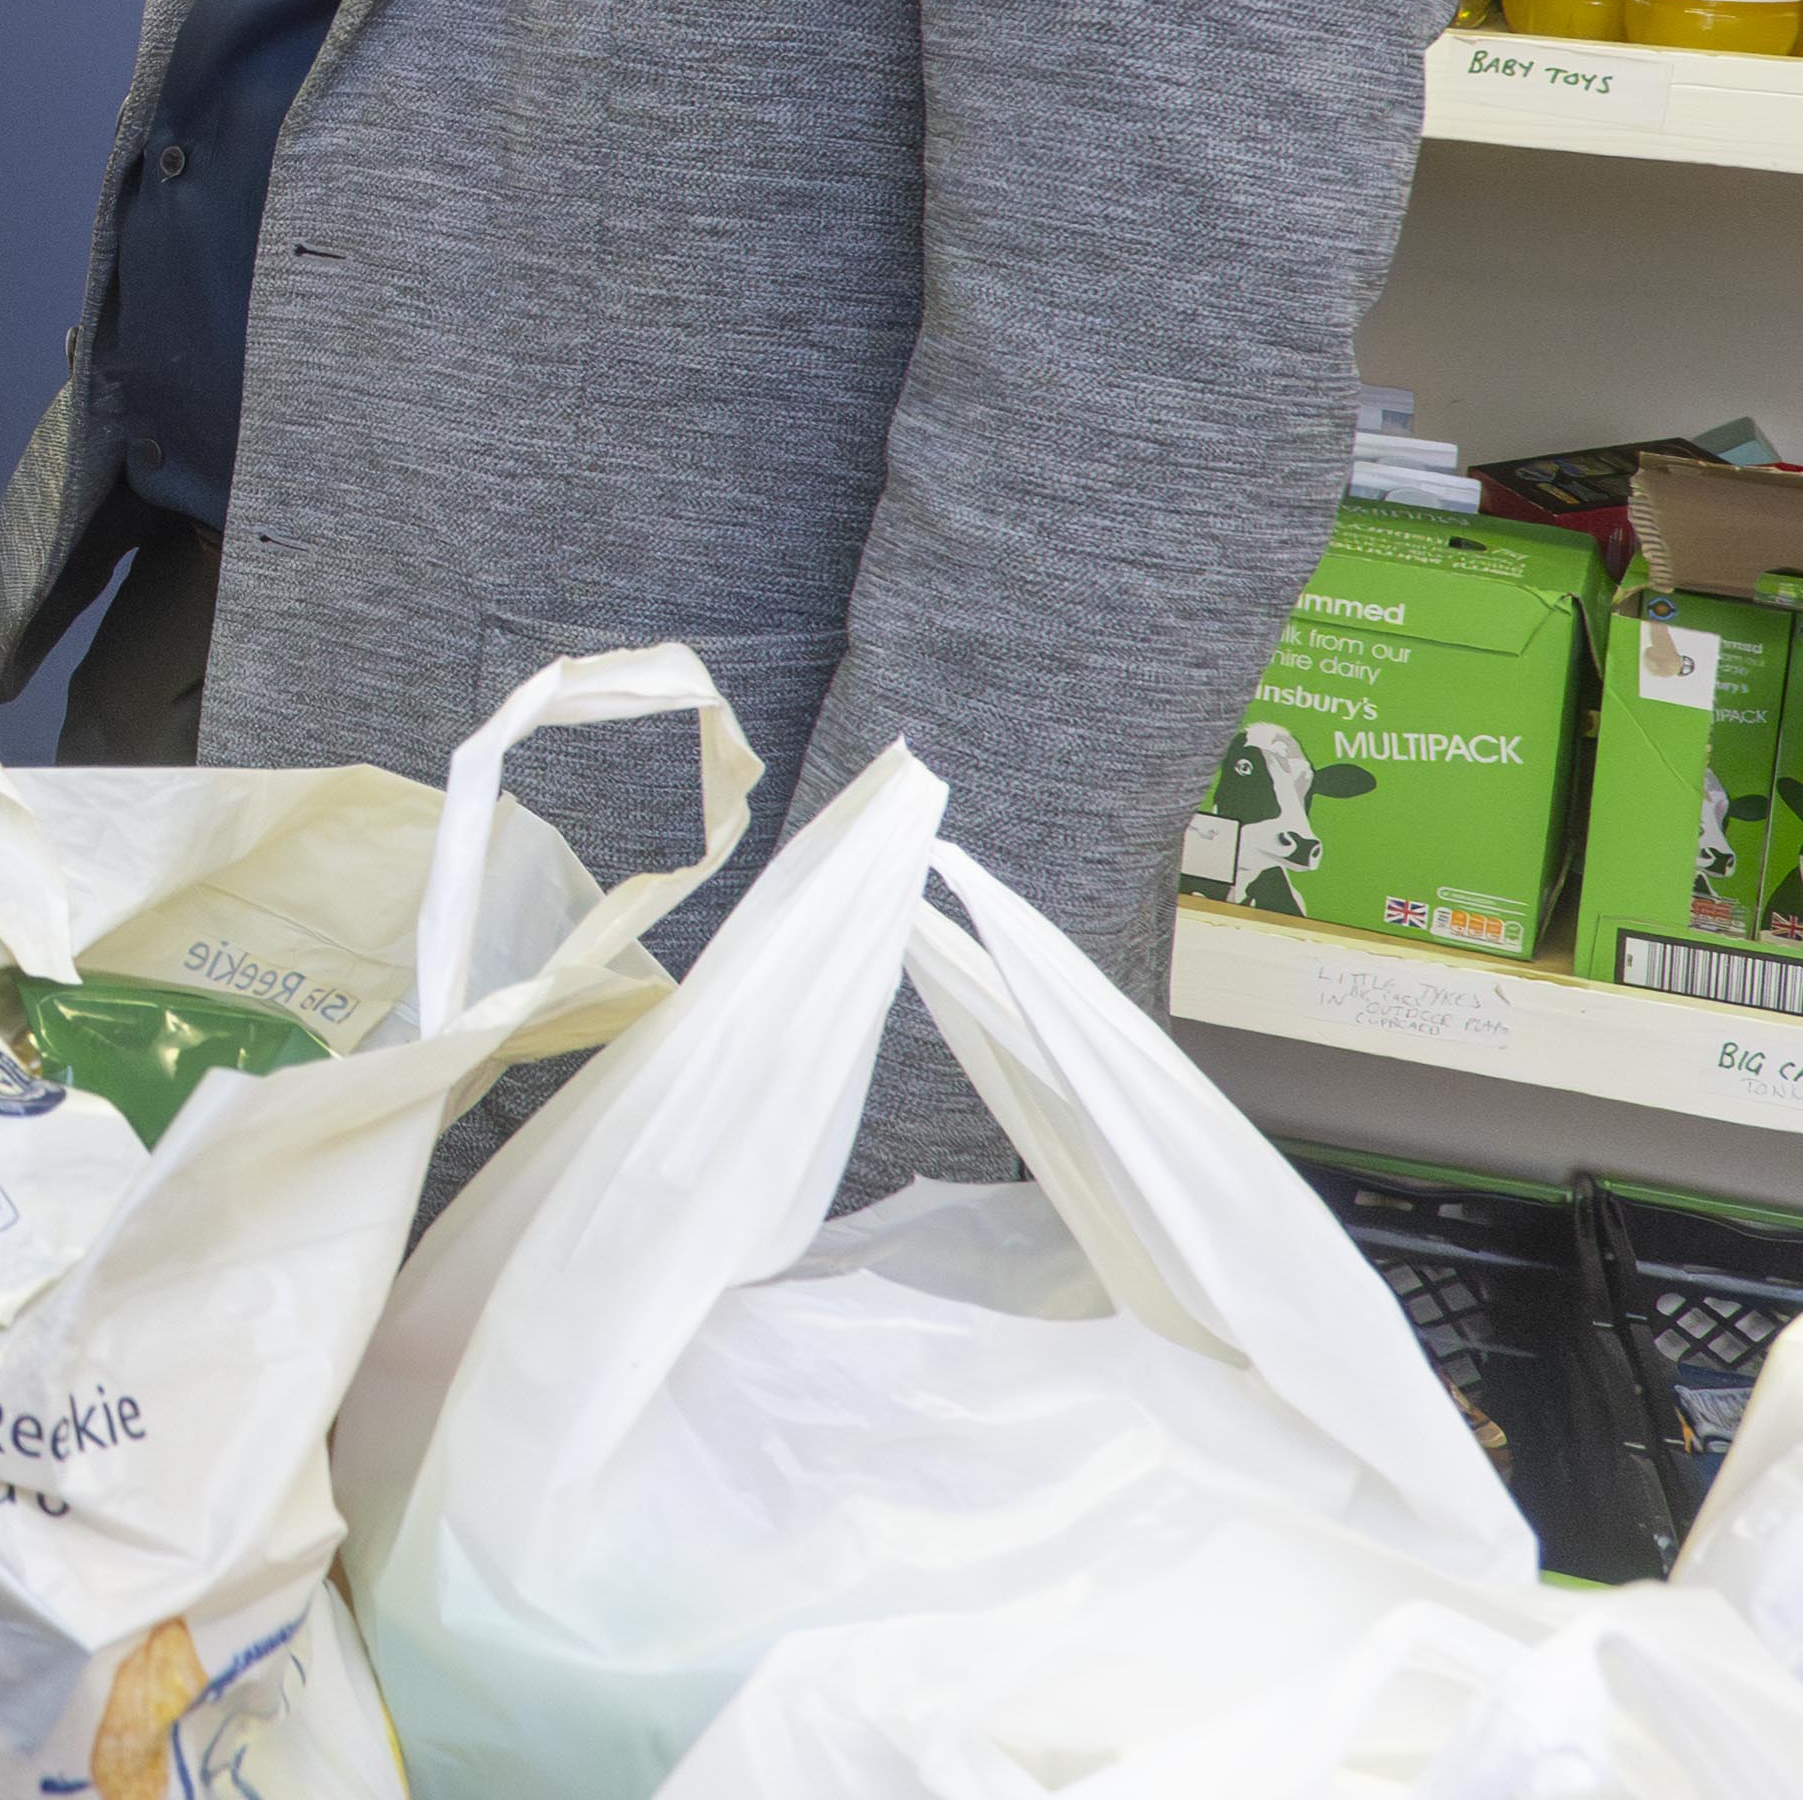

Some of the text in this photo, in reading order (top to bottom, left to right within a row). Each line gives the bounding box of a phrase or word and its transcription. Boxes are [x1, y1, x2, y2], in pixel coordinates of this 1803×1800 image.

[1468, 50, 1613, 94] BABY TOYS
[1309, 629, 1364, 655] from
[1371, 643, 1411, 663] our
[1319, 653, 1381, 686] dairy
[1255, 684, 1378, 720] insbury's
[1334, 731, 1523, 765] MULTIPACK
[1718, 1041, 1766, 1076] BIG
